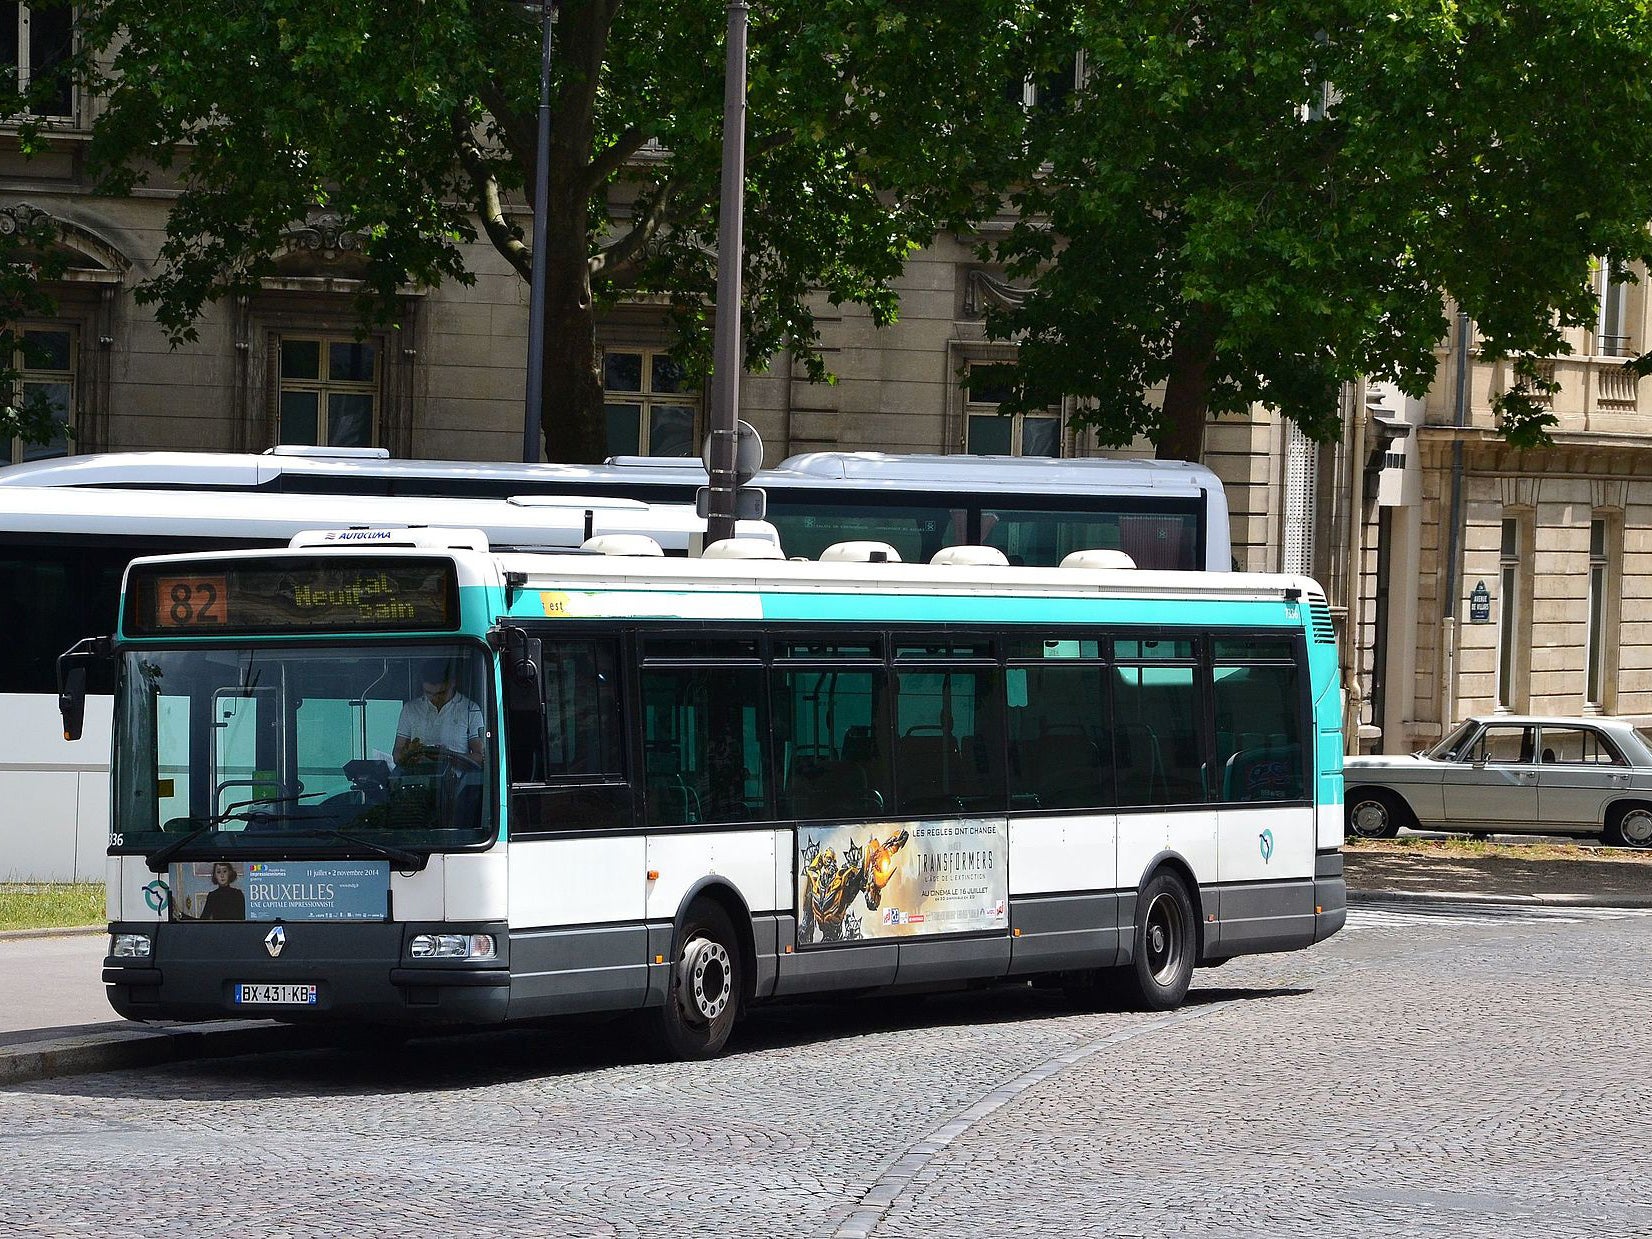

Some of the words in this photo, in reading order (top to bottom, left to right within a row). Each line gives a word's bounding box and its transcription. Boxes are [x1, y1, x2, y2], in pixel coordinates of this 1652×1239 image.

[338, 531, 391, 540] AUTOCLIMA
[170, 583, 219, 624] 82
[1473, 595, 1488, 603] AVENUE
[912, 829, 925, 838] LES
[954, 827, 968, 836] ONT
[917, 850, 993, 876] TRANSFORMERS
[313, 869, 328, 878] juillet
[249, 883, 335, 901] BRUXELLES
[921, 889, 930, 897] AU
[959, 887, 966, 895] 16
[966, 886, 989, 894] JUILLET
[242, 986, 309, 1002] BX-431-KB
[309, 994, 317, 1002] 75
